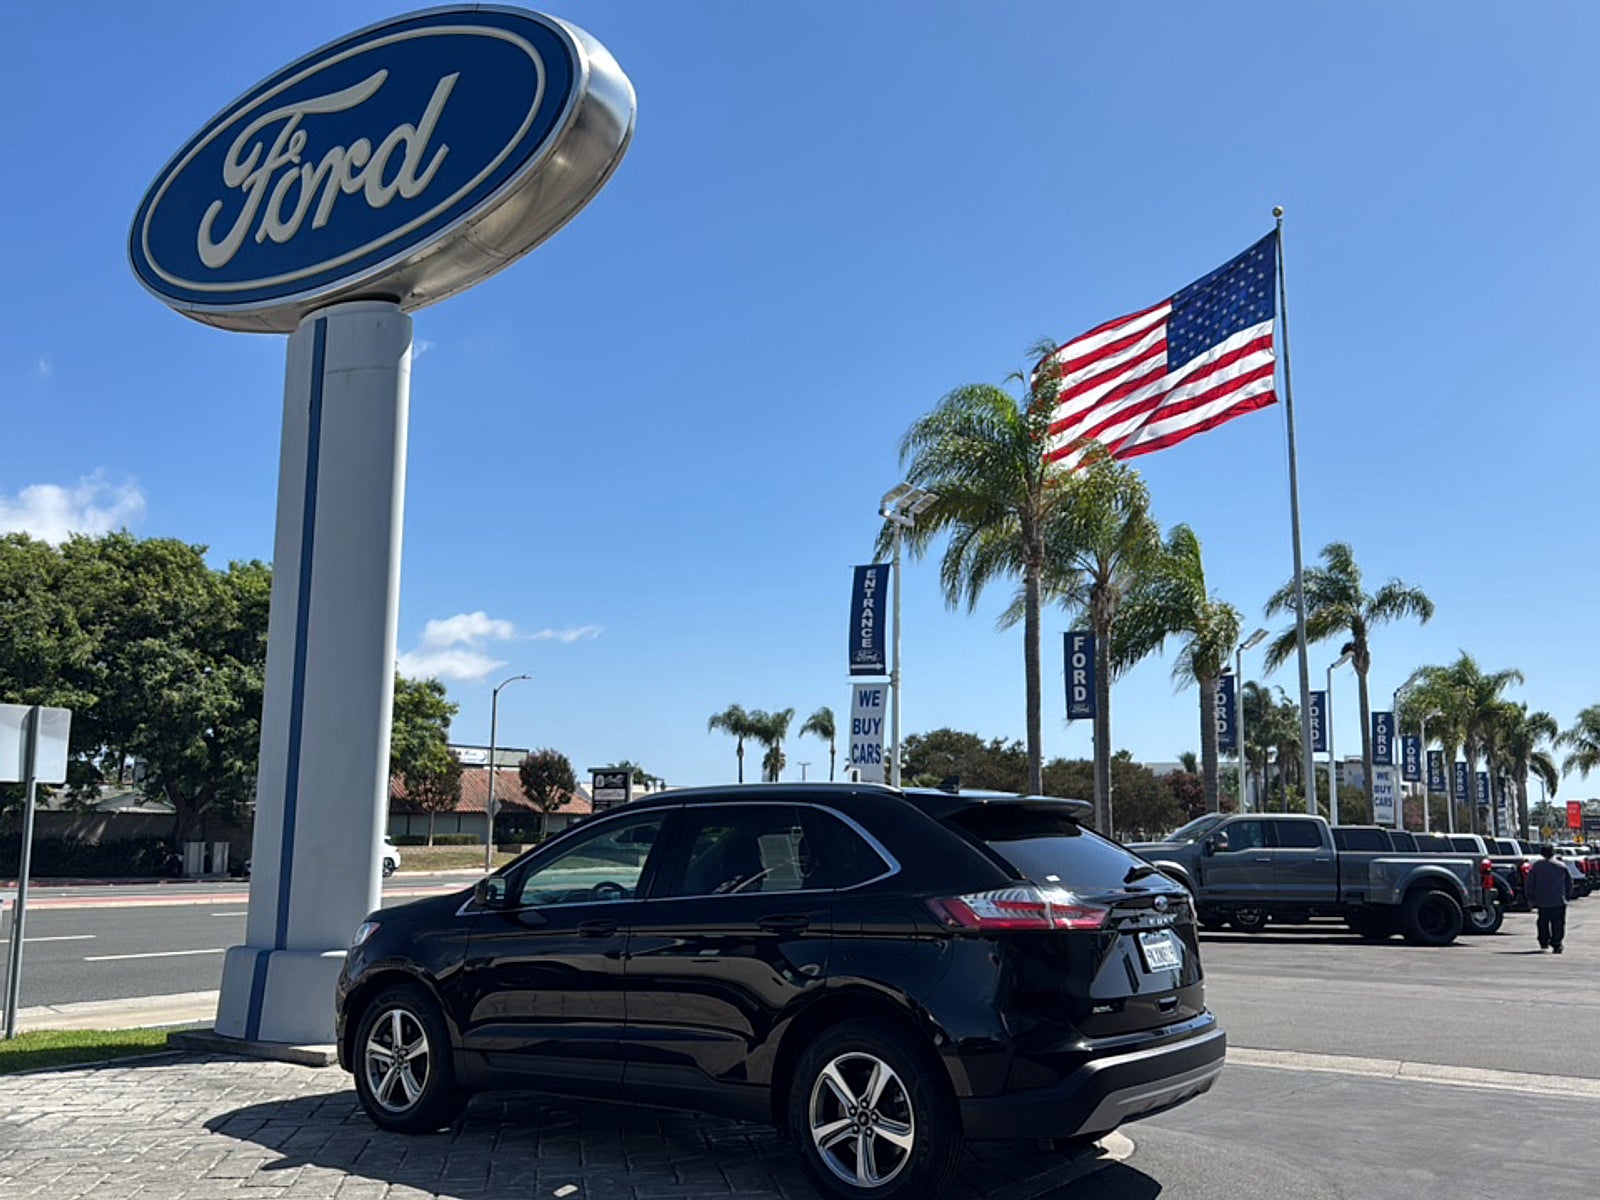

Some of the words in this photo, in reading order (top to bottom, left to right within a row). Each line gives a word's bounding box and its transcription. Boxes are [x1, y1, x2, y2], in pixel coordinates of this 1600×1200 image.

[197, 68, 460, 268] Ford
[861, 569, 877, 648] ENTRANCE
[1072, 636, 1087, 702] FORD
[859, 690, 881, 707] WE
[853, 718, 881, 735] BUY
[1376, 714, 1387, 755] FORD
[852, 743, 881, 764] CARS
[1406, 738, 1416, 773] FORD
